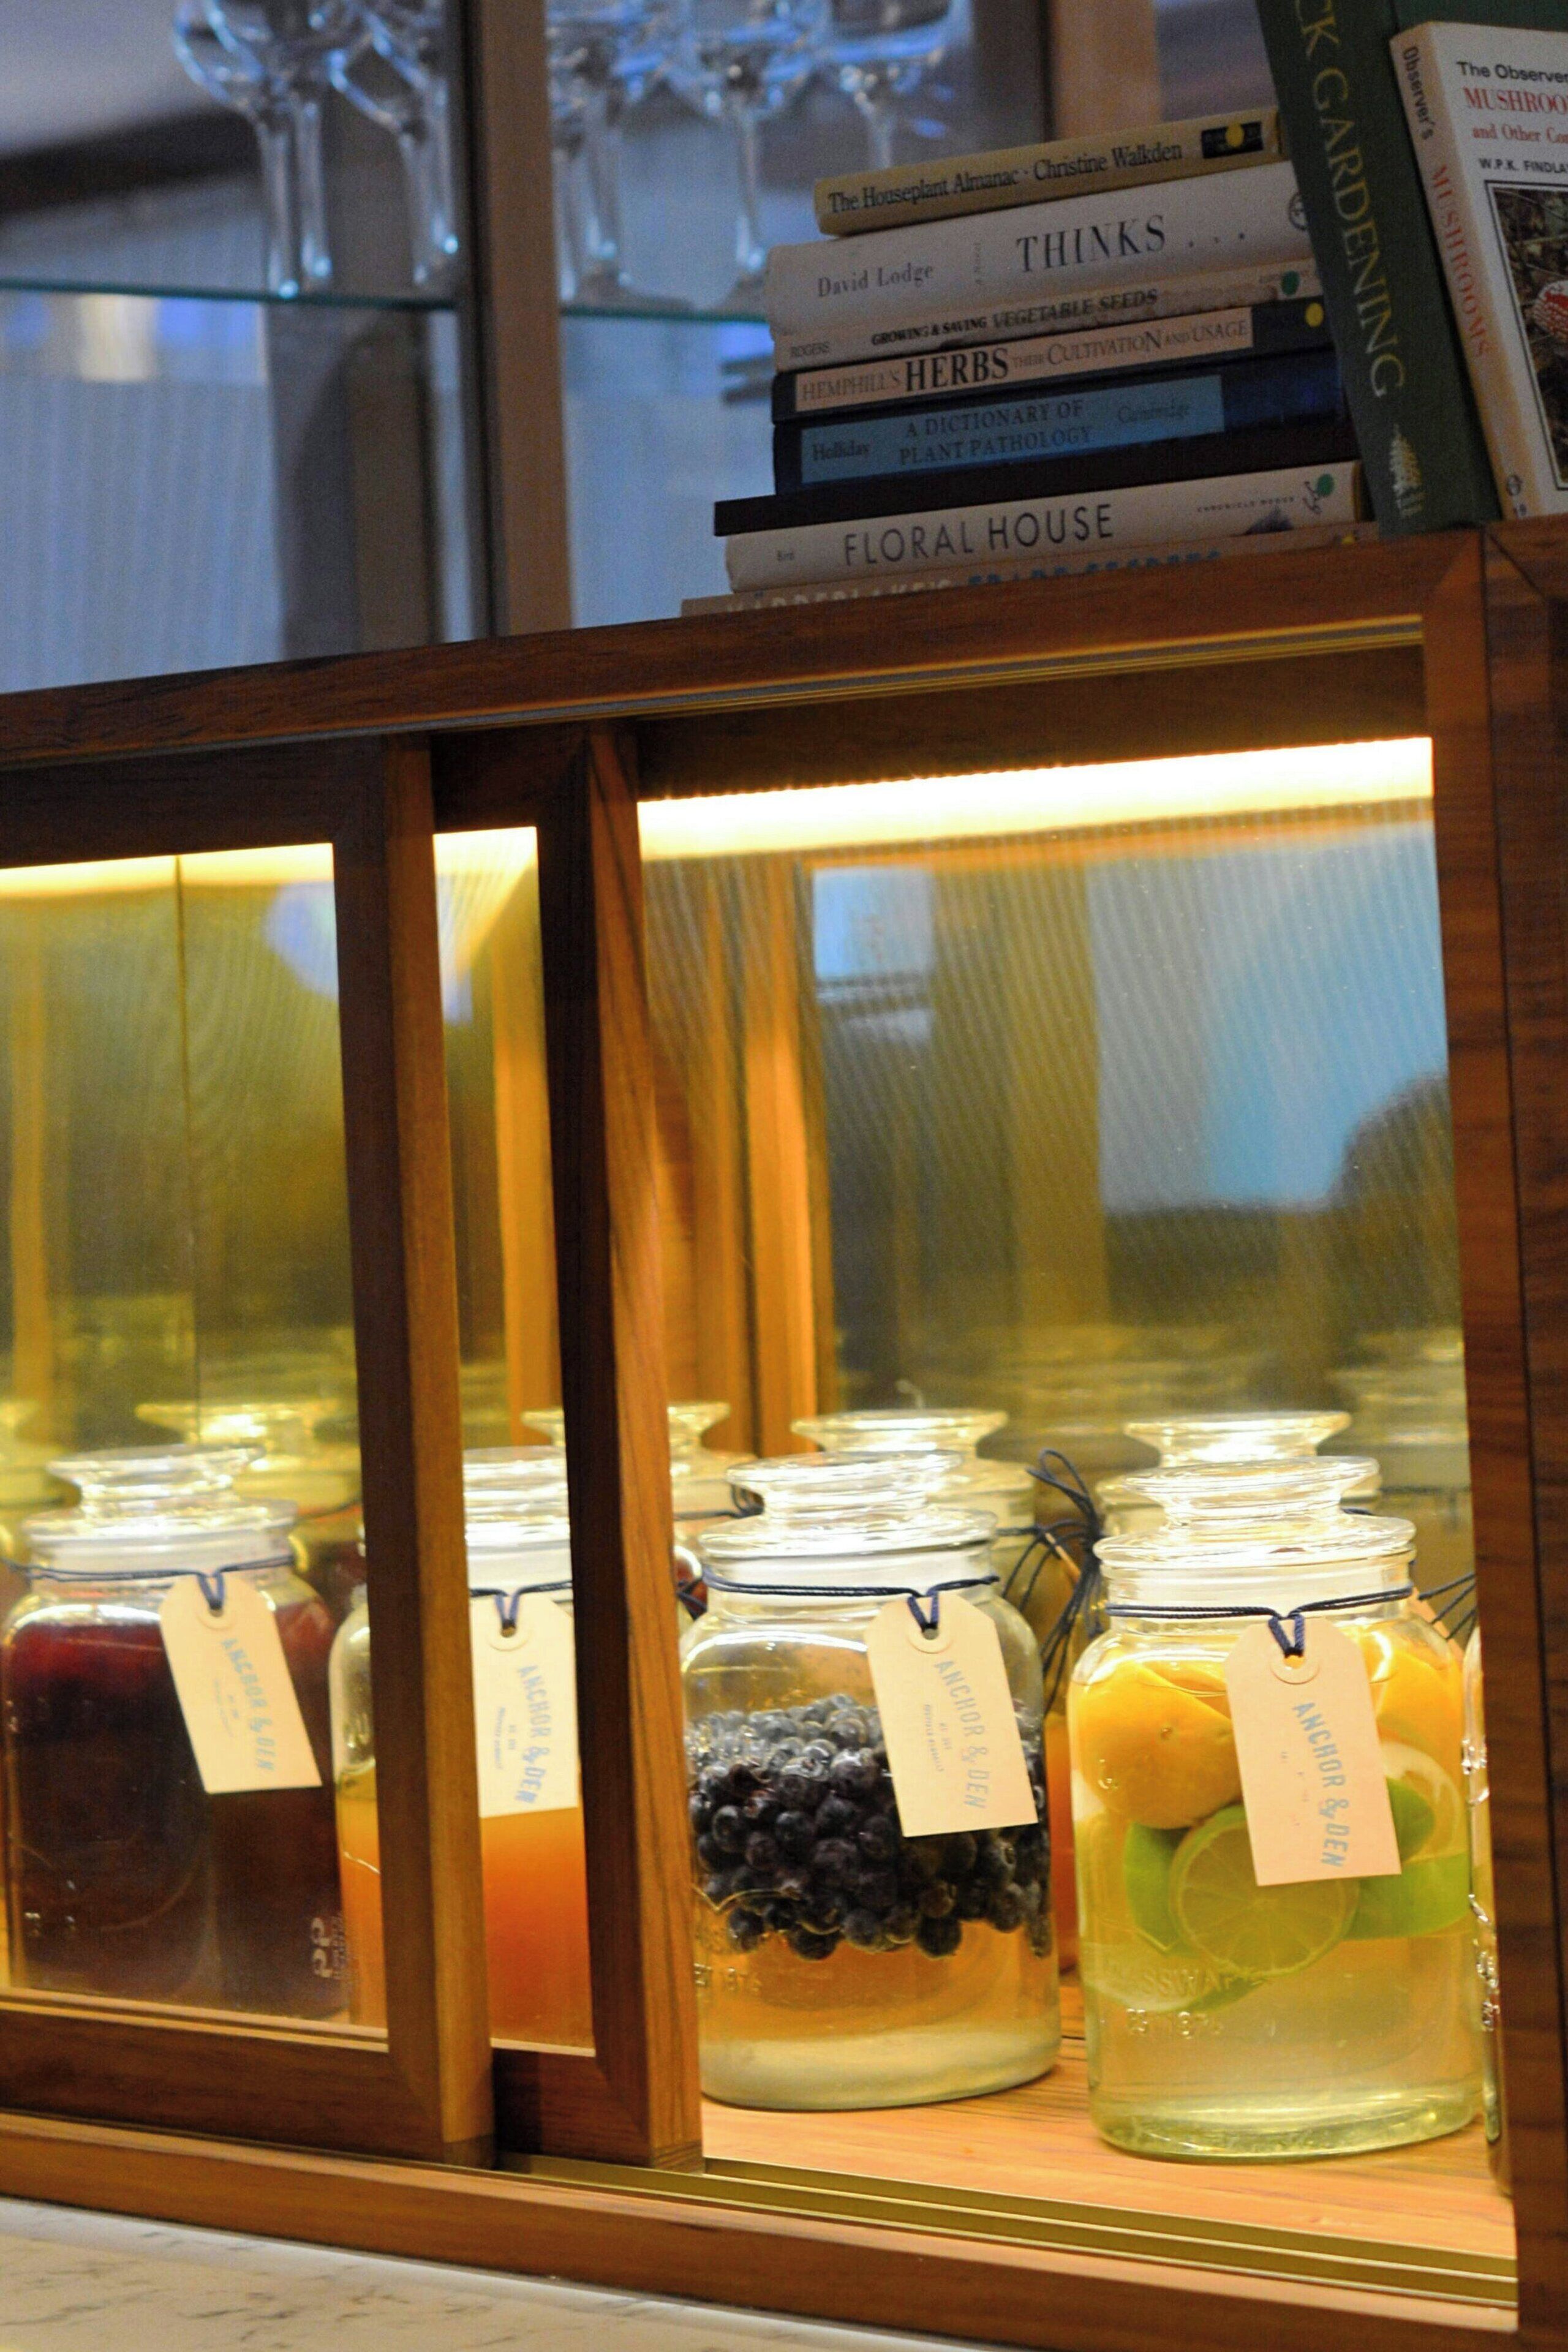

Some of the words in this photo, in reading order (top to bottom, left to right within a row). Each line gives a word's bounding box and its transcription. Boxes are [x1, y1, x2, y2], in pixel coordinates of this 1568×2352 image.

[1456, 61, 1491, 78] The
[1472, 124, 1498, 140] and
[1502, 124, 1542, 141] Other
[828, 191, 858, 213] The
[862, 179, 949, 208] Houseplant
[953, 170, 1019, 194] Almanac
[1033, 153, 1107, 181] Christine
[1111, 141, 1183, 169] Walkden
[1523, 160, 1568, 174] FINDLA
[1403, 45, 1435, 140] Observer's
[1433, 165, 1490, 358] MUSHROOMS
[1313, 67, 1404, 398] GARDENING
[817, 271, 869, 298] David
[876, 261, 934, 288] Lodge
[1016, 214, 1166, 273] THINKS
[942, 315, 988, 335] SAVING
[992, 298, 1095, 329] VEGETABLE
[1099, 288, 1159, 308] SEEDS
[905, 347, 1009, 392] HERBS
[1193, 320, 1247, 343] USAGE
[907, 422, 918, 438] A
[925, 402, 1051, 436] DICTIONARY
[1057, 399, 1084, 419] OF
[900, 440, 965, 466] PLANT
[970, 426, 1093, 456] PATHOLOGY
[844, 521, 974, 567] FLORAL
[988, 503, 1115, 552] HOUSE
[517, 1664, 552, 1738] ANCHOR
[933, 1659, 985, 1738] ANCHOR
[960, 1745, 990, 1765] &
[1292, 1701, 1346, 1788] ANCHOR
[515, 1766, 547, 1804] DEN
[963, 1768, 990, 1809] DEN
[1319, 1797, 1350, 1820] &
[1319, 1822, 1351, 1868] DEN
